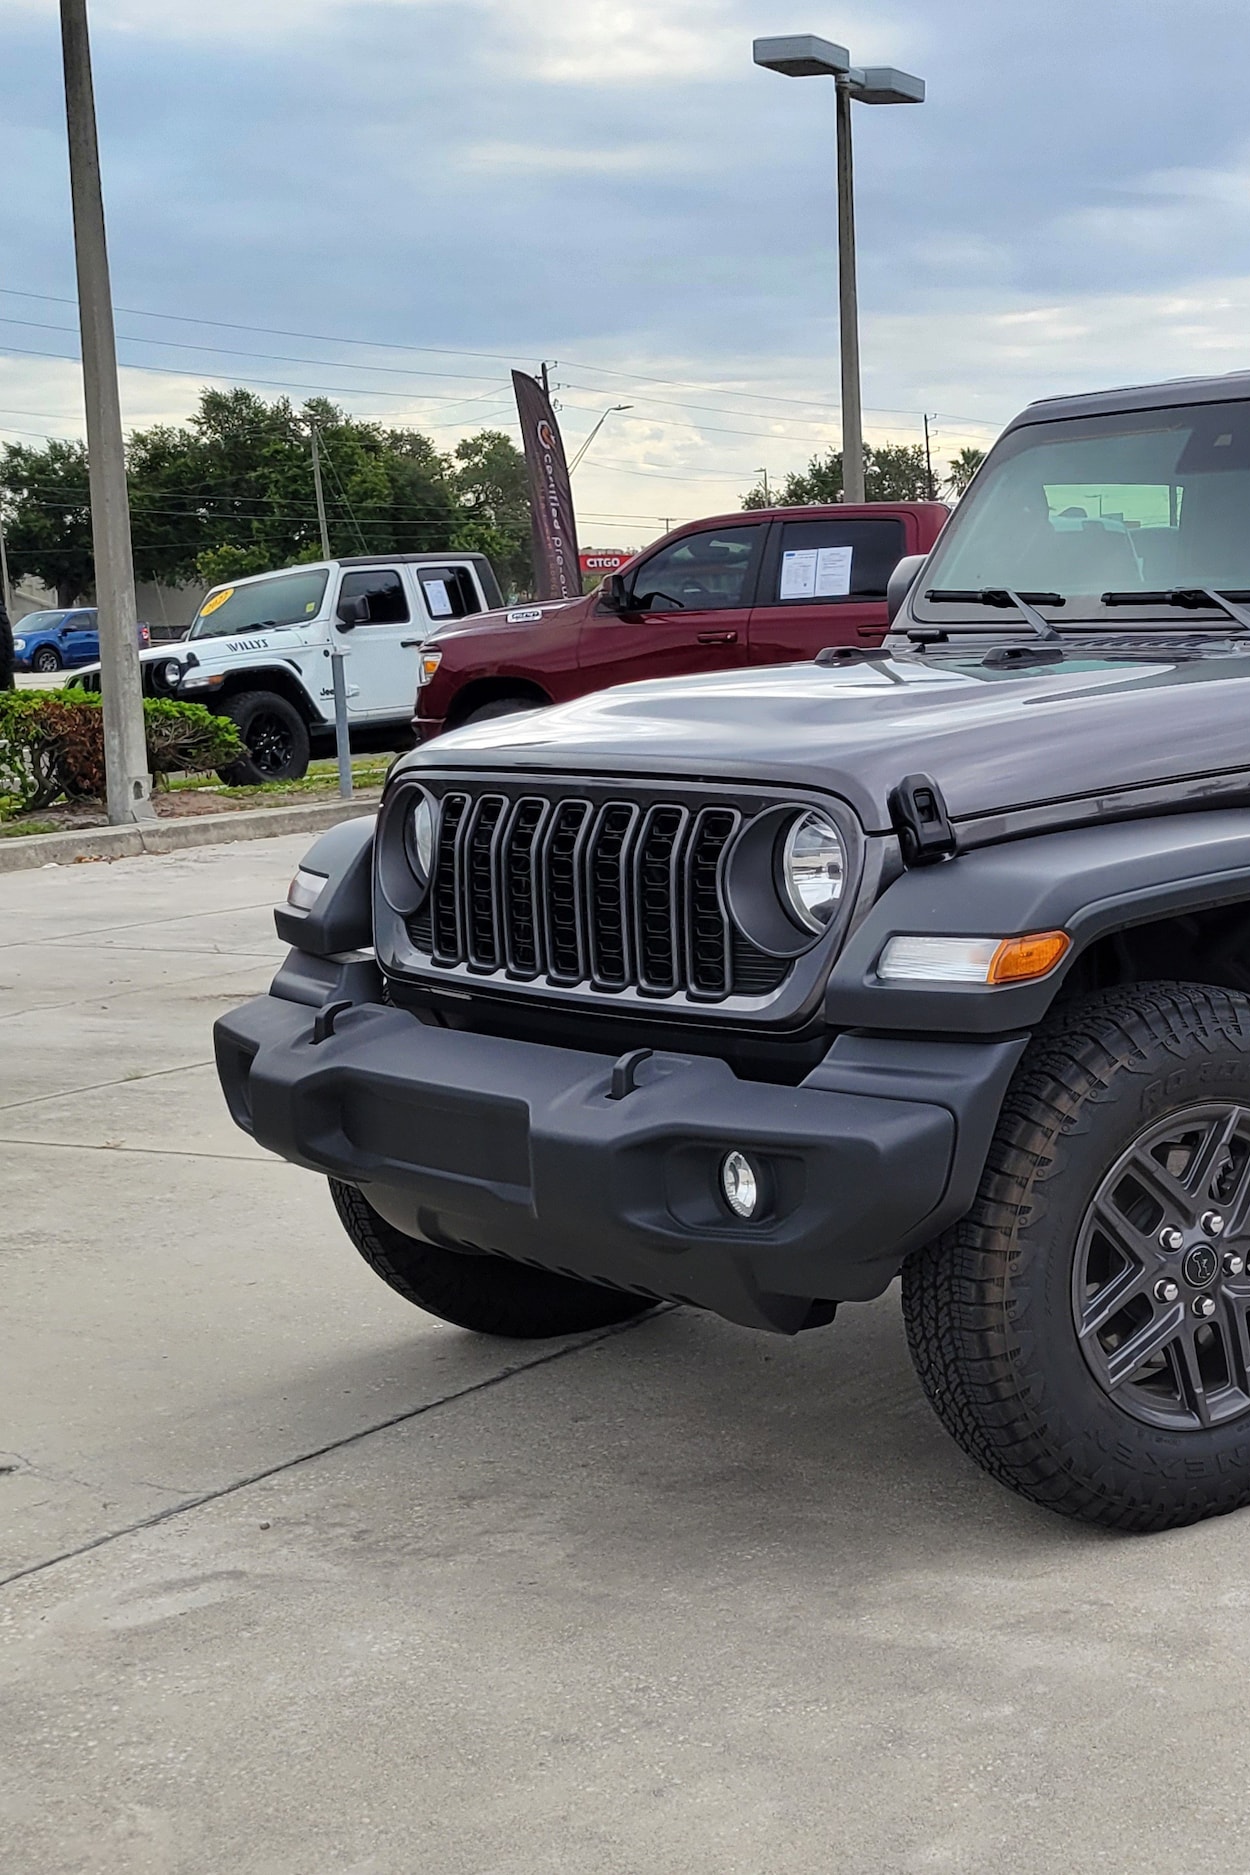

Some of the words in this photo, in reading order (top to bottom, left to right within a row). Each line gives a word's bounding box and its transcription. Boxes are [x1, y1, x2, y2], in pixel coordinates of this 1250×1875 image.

[544, 453, 561, 529] certified
[551, 536, 569, 599] pre-ow
[586, 557, 620, 568] CITGO
[226, 639, 269, 652] WILLYS
[320, 687, 335, 696] Jee
